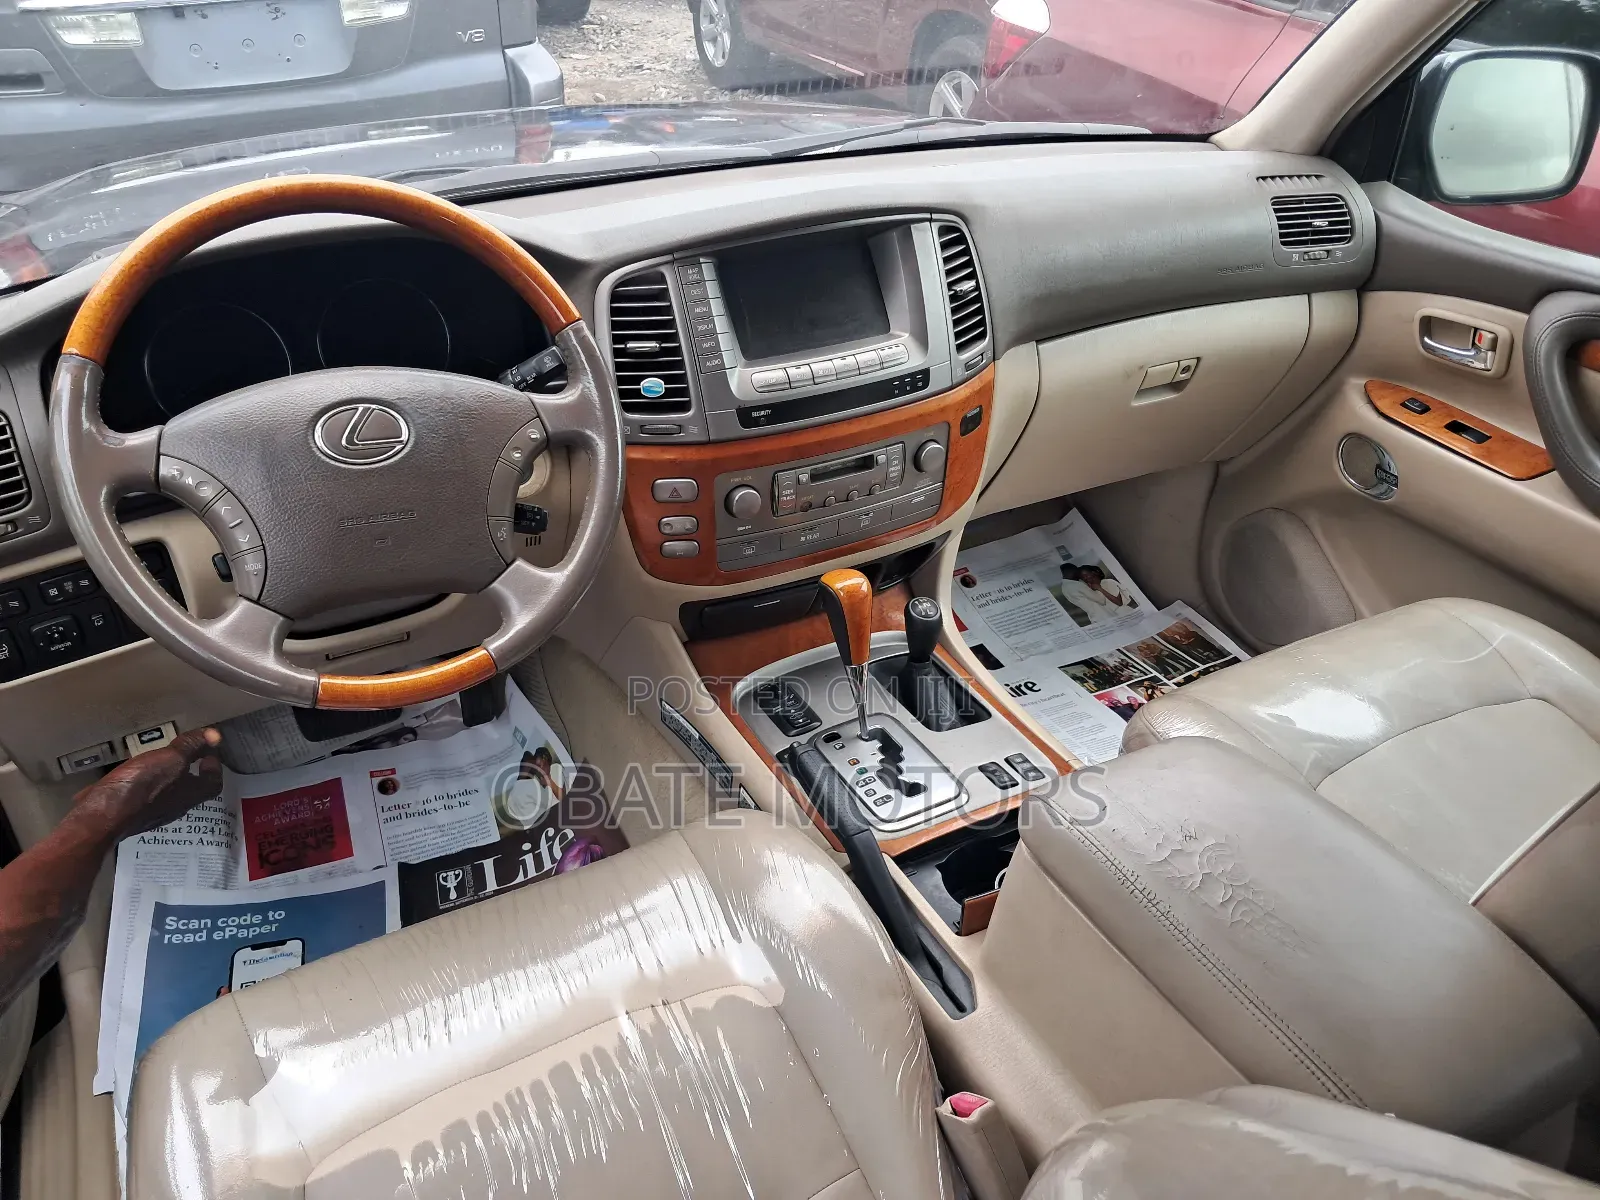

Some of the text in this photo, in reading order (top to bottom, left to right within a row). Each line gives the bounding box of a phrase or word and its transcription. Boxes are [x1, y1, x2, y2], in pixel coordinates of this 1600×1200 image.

[456, 28, 485, 44] V8
[705, 358, 722, 367] AUDIO
[751, 409, 772, 418] SECURITY
[244, 562, 263, 572] MODE
[970, 591, 992, 602] Letter
[1013, 578, 1036, 589] brides
[977, 587, 1034, 610] and brides-to-be
[380, 802, 412, 814] Letter
[434, 794, 444, 802] to
[445, 787, 480, 800] brides
[186, 813, 231, 828] Emerging
[382, 799, 471, 825] and brides-to-be
[172, 826, 182, 834] at
[186, 825, 216, 837] 2024
[137, 835, 232, 849] Achievers Awards
[473, 827, 576, 895] Life
[164, 909, 286, 931] Scan code to
[163, 921, 280, 944] read ePaper
